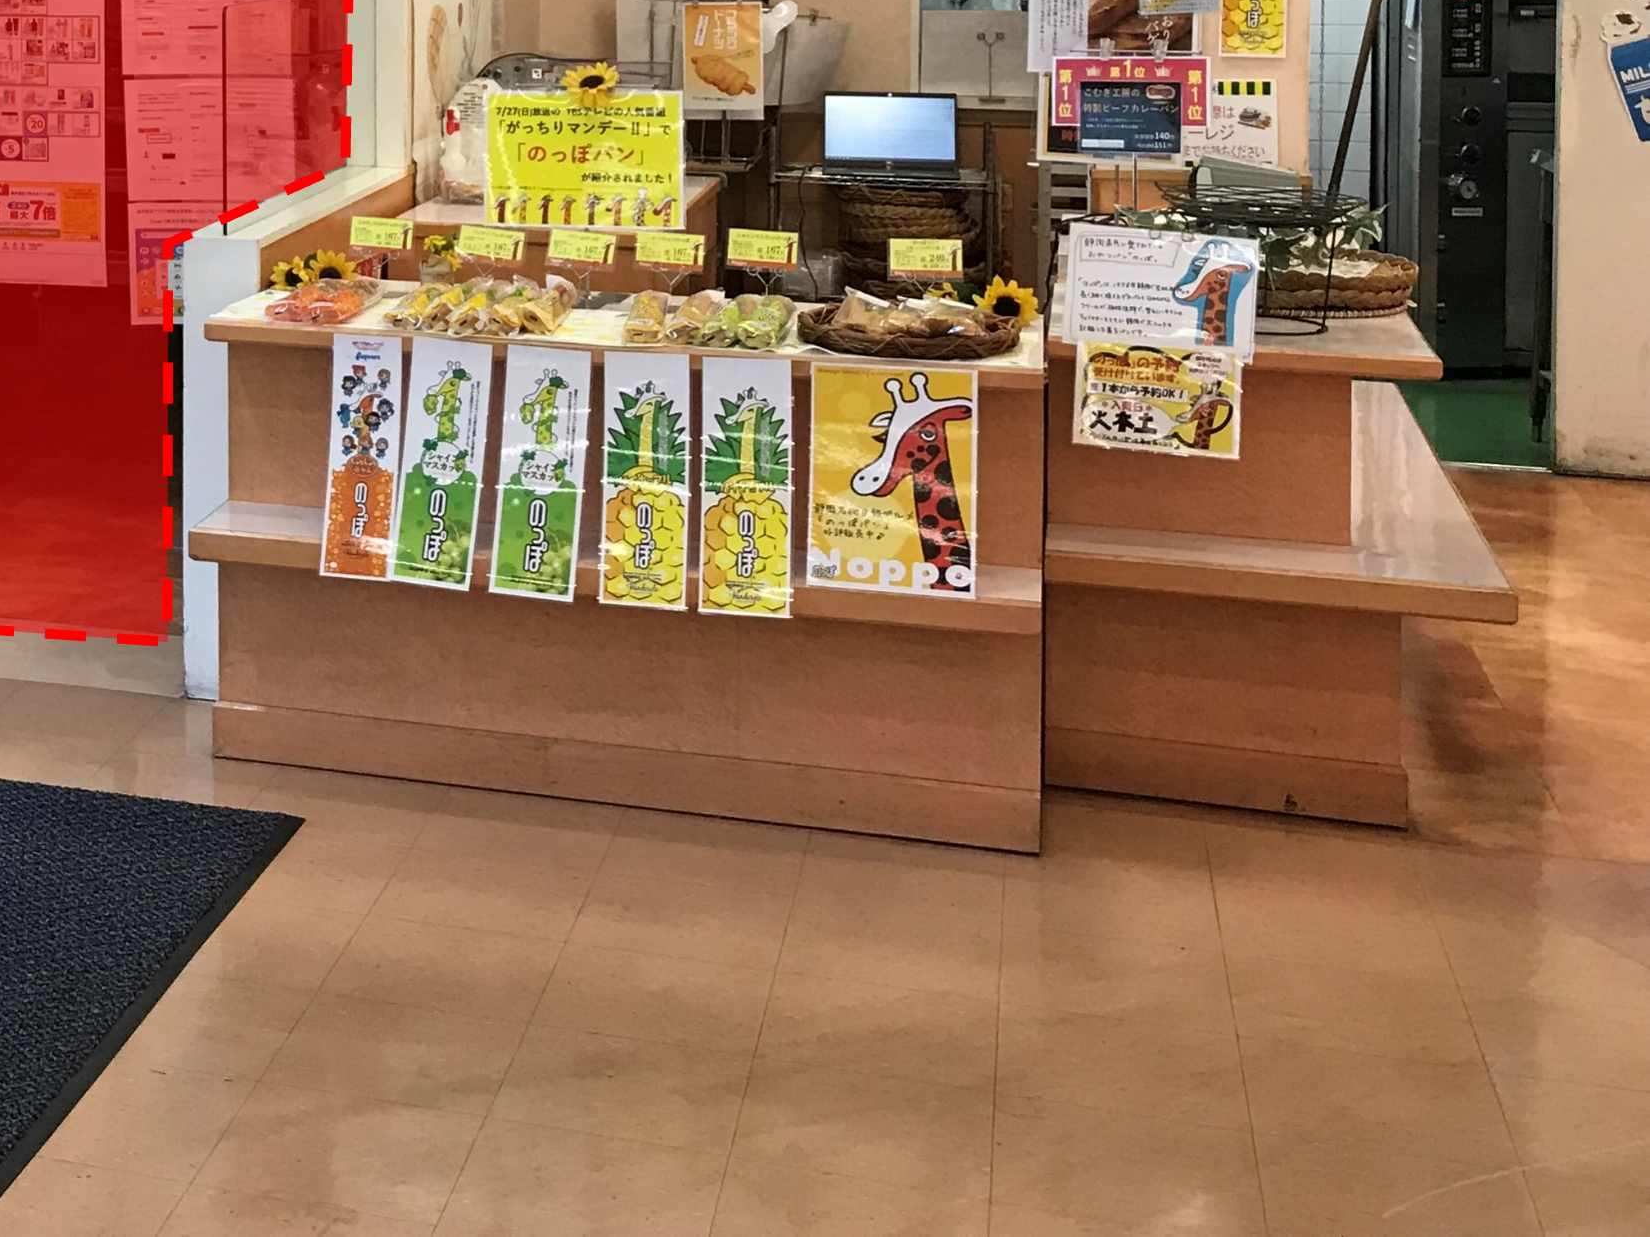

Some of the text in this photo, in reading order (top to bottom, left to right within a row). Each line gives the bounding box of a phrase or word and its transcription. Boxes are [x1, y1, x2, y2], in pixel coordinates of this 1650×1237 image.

[1110, 60, 1145, 78] 第1位
[1620, 65, 1650, 83] MIL
[1058, 69, 1073, 118] 第1位
[1083, 88, 1140, 98] こむぎ工房の
[1187, 69, 1203, 120] 第1位
[496, 107, 560, 118] 7/27(日)放送の
[1083, 103, 1179, 114] 特製ビーフカレーパン
[1185, 125, 1234, 141] ーレジ
[517, 142, 646, 166] 「のっぽパン」
[581, 172, 673, 184] が紹介されました！
[1090, 411, 1158, 434] 火木土
[351, 482, 369, 538] のっぽ
[422, 488, 447, 562] のっぽ
[524, 499, 549, 573] のっぽ
[635, 502, 655, 569] のっぽ
[737, 510, 757, 577] のっぽ
[808, 546, 972, 589] Noppo
